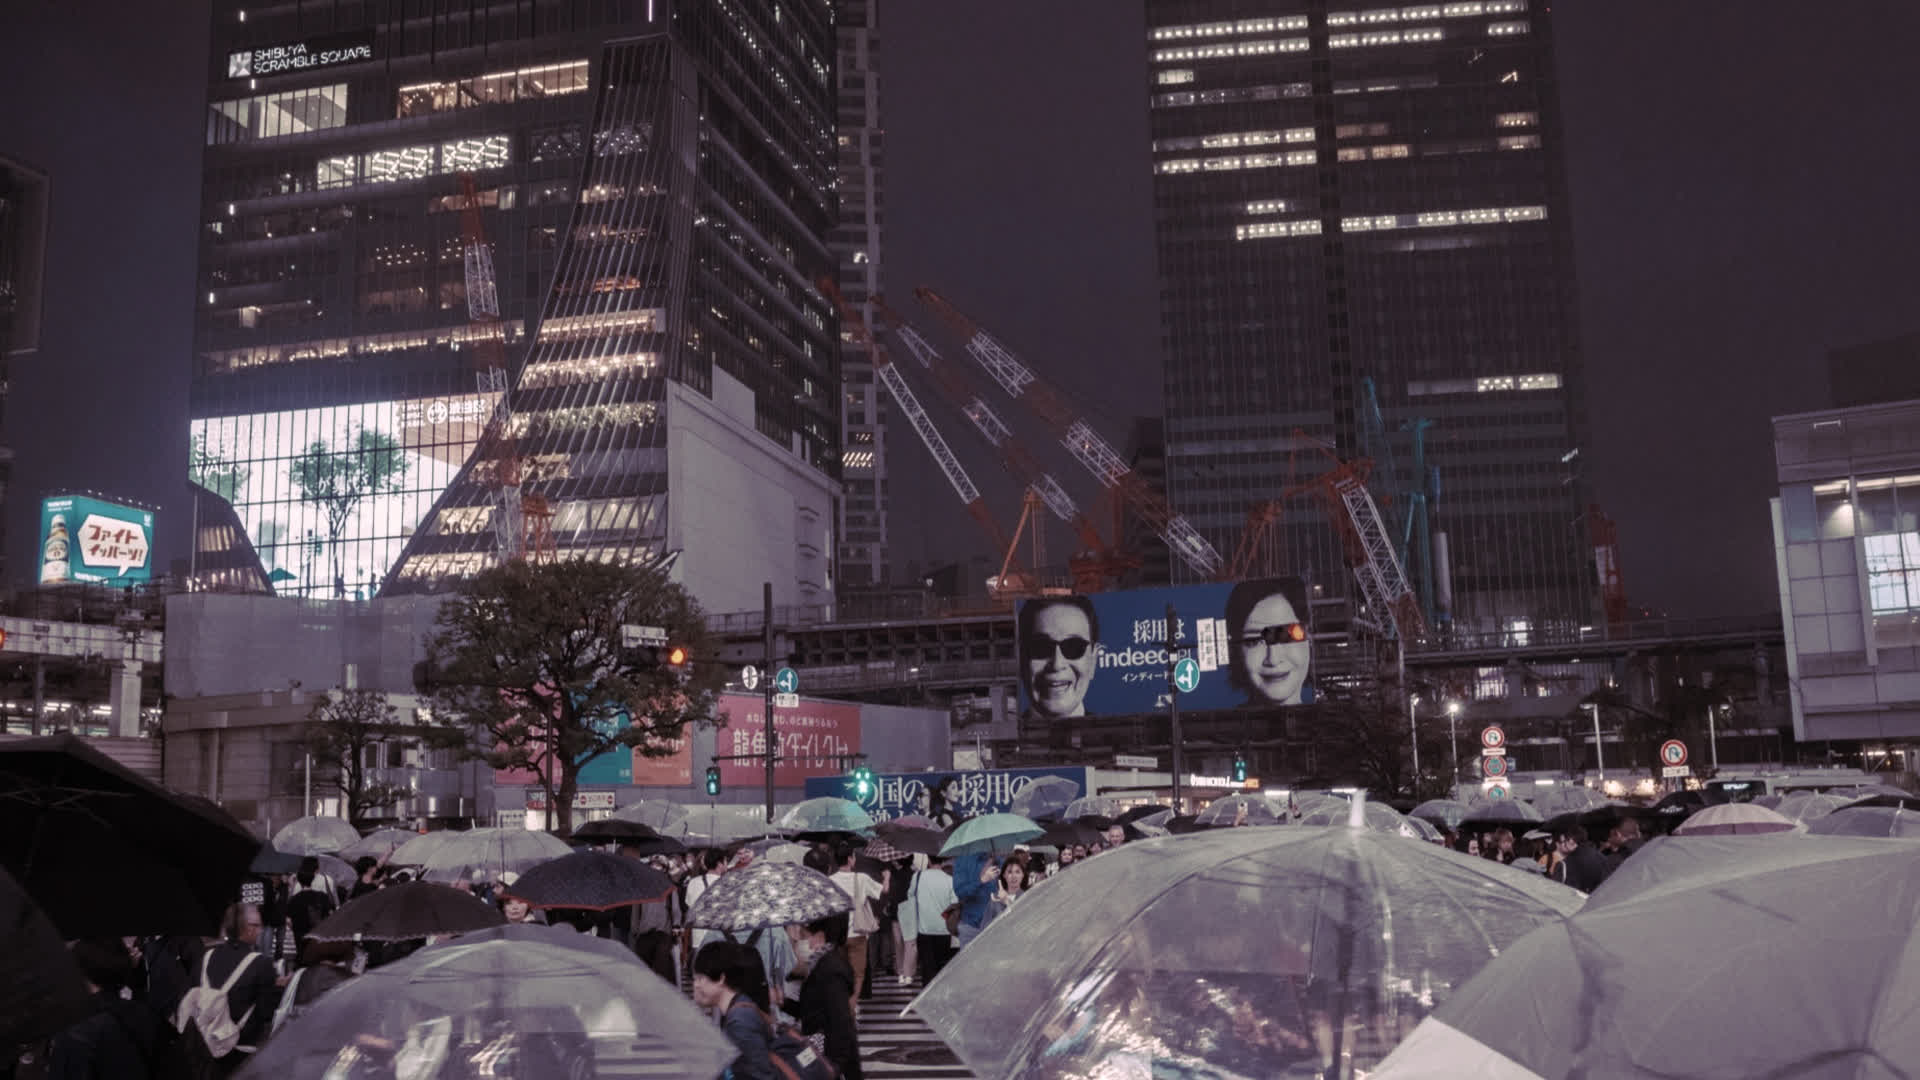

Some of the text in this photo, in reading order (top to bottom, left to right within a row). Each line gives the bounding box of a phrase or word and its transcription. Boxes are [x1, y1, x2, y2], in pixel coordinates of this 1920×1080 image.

[254, 44, 307, 62] SHIBUYA
[254, 46, 371, 74] SCRAMBLE SQUARE
[88, 524, 139, 545] ファイト
[1133, 618, 1185, 644] 採用は
